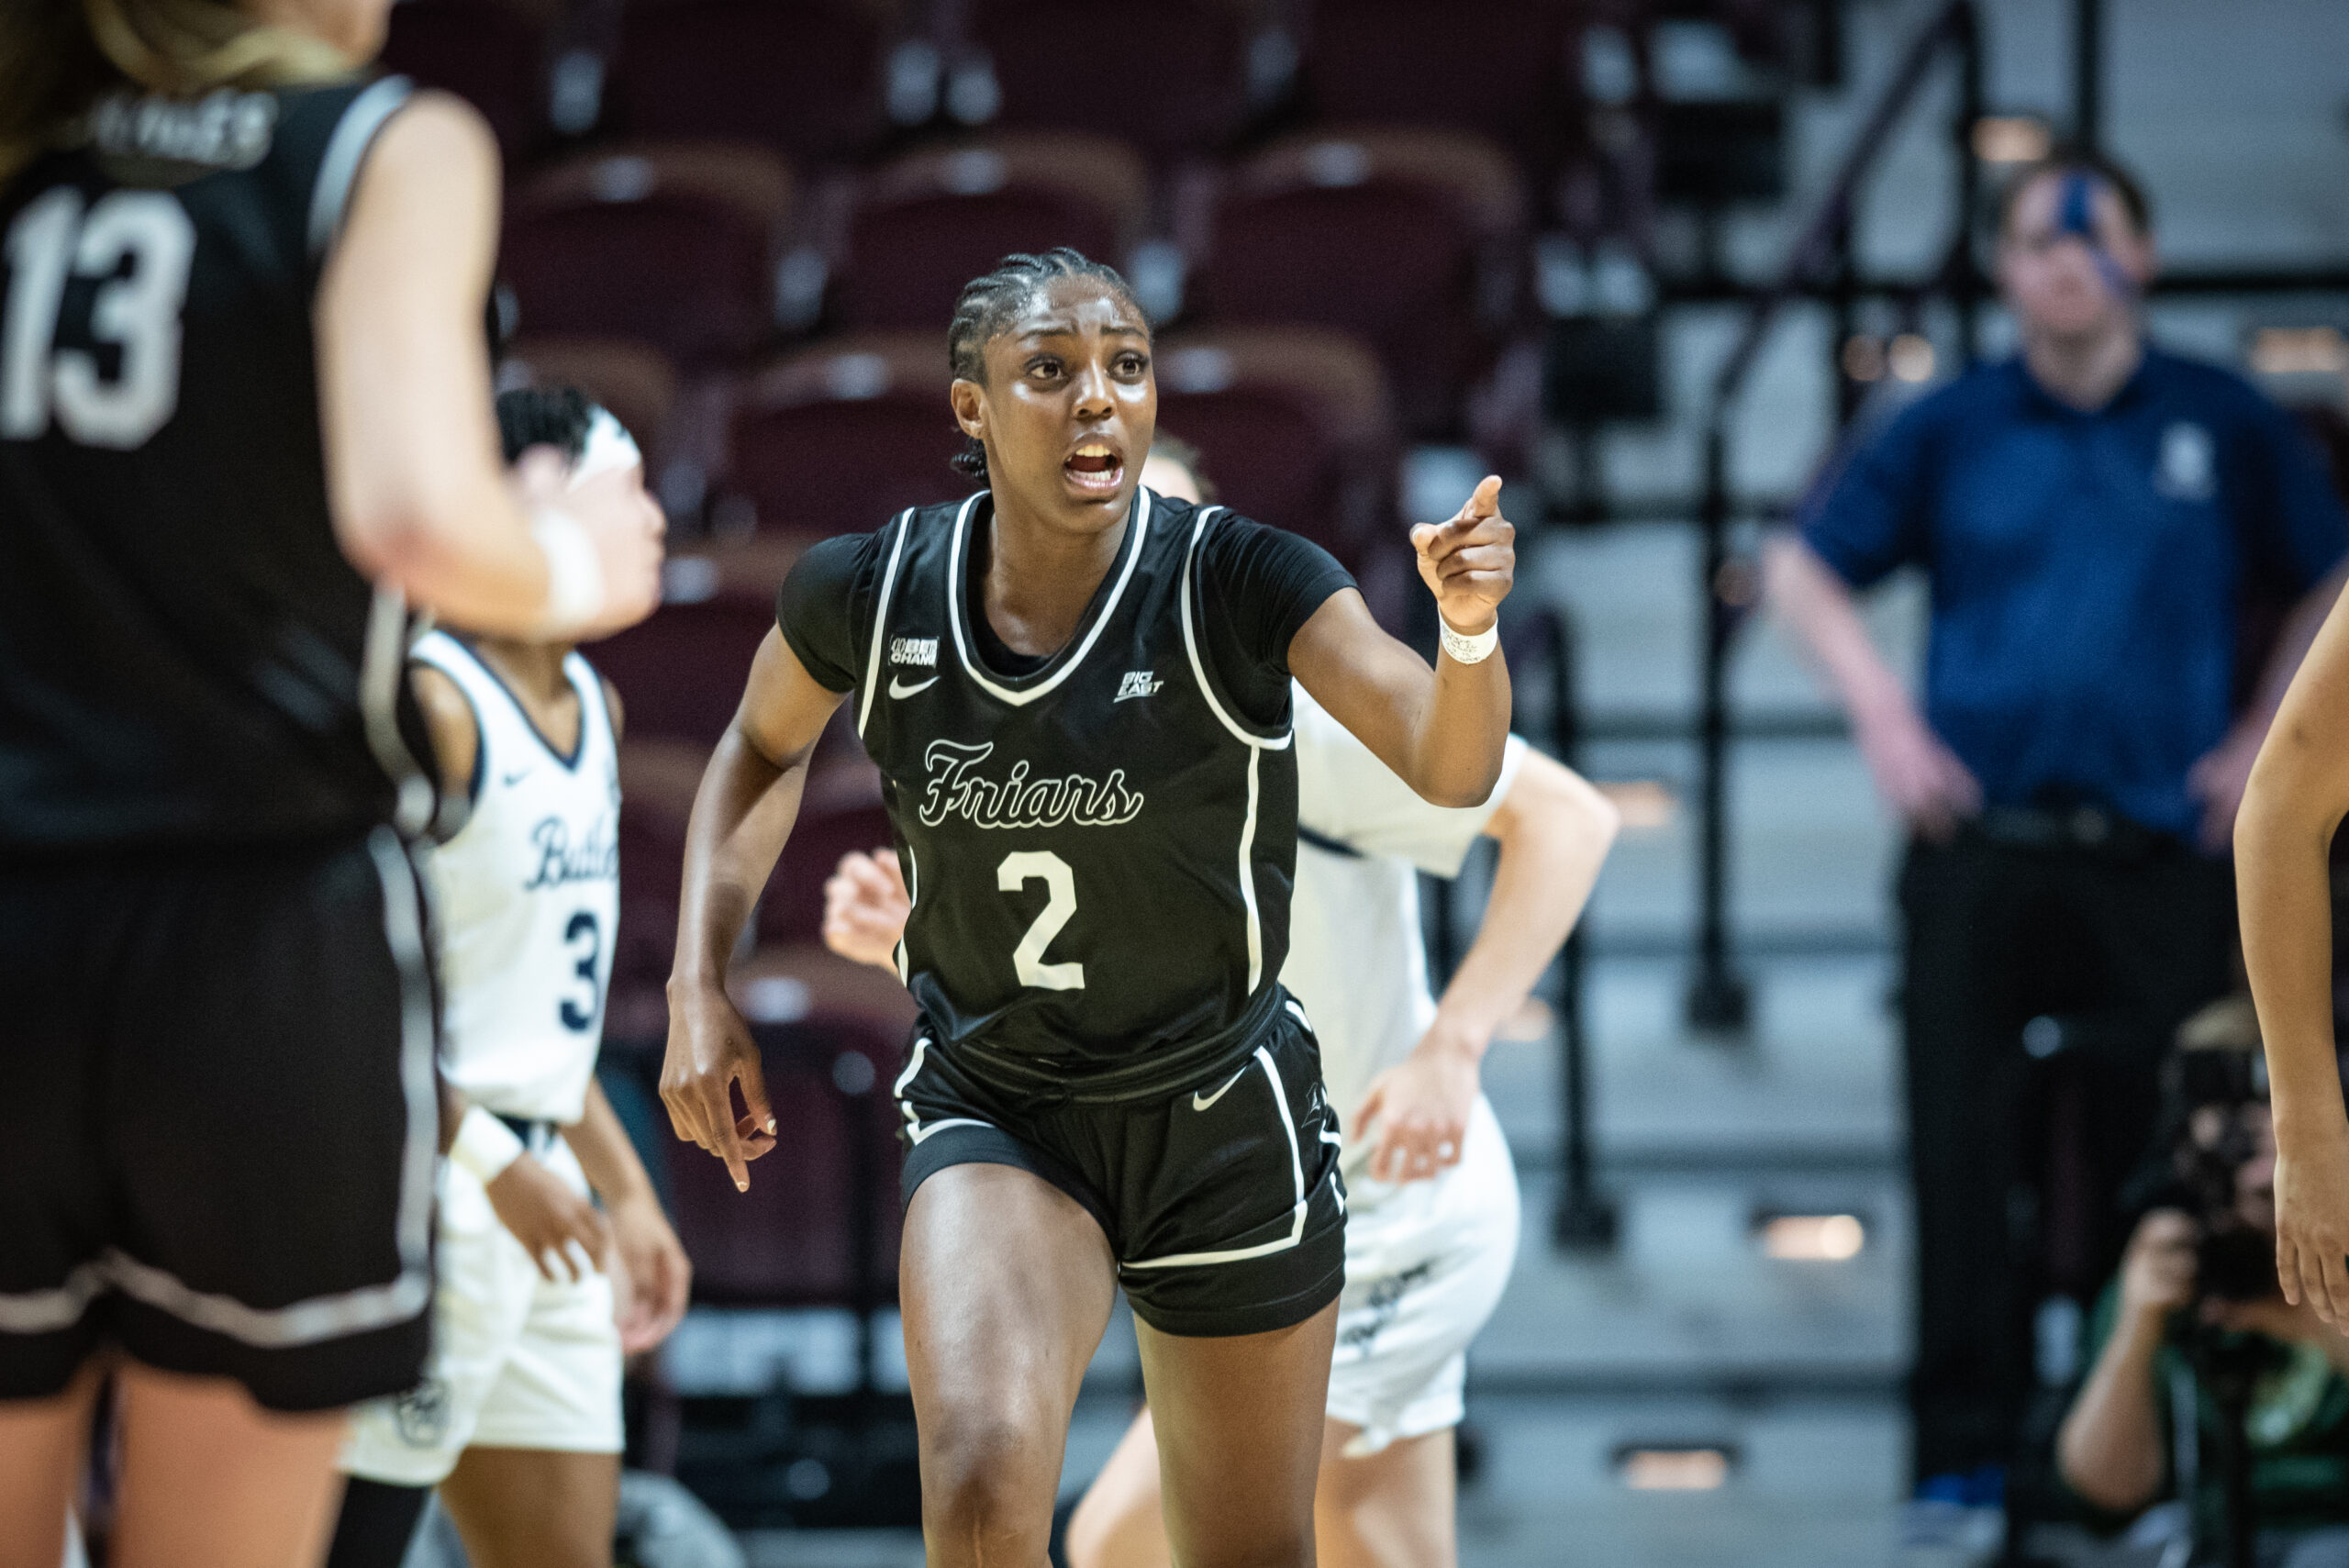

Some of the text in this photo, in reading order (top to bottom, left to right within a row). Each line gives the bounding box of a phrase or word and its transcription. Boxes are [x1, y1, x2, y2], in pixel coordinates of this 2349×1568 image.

[1, 184, 197, 451] 13
[919, 739, 1144, 828] Friars
[561, 910, 602, 1032] 3
[997, 851, 1085, 991] 2
